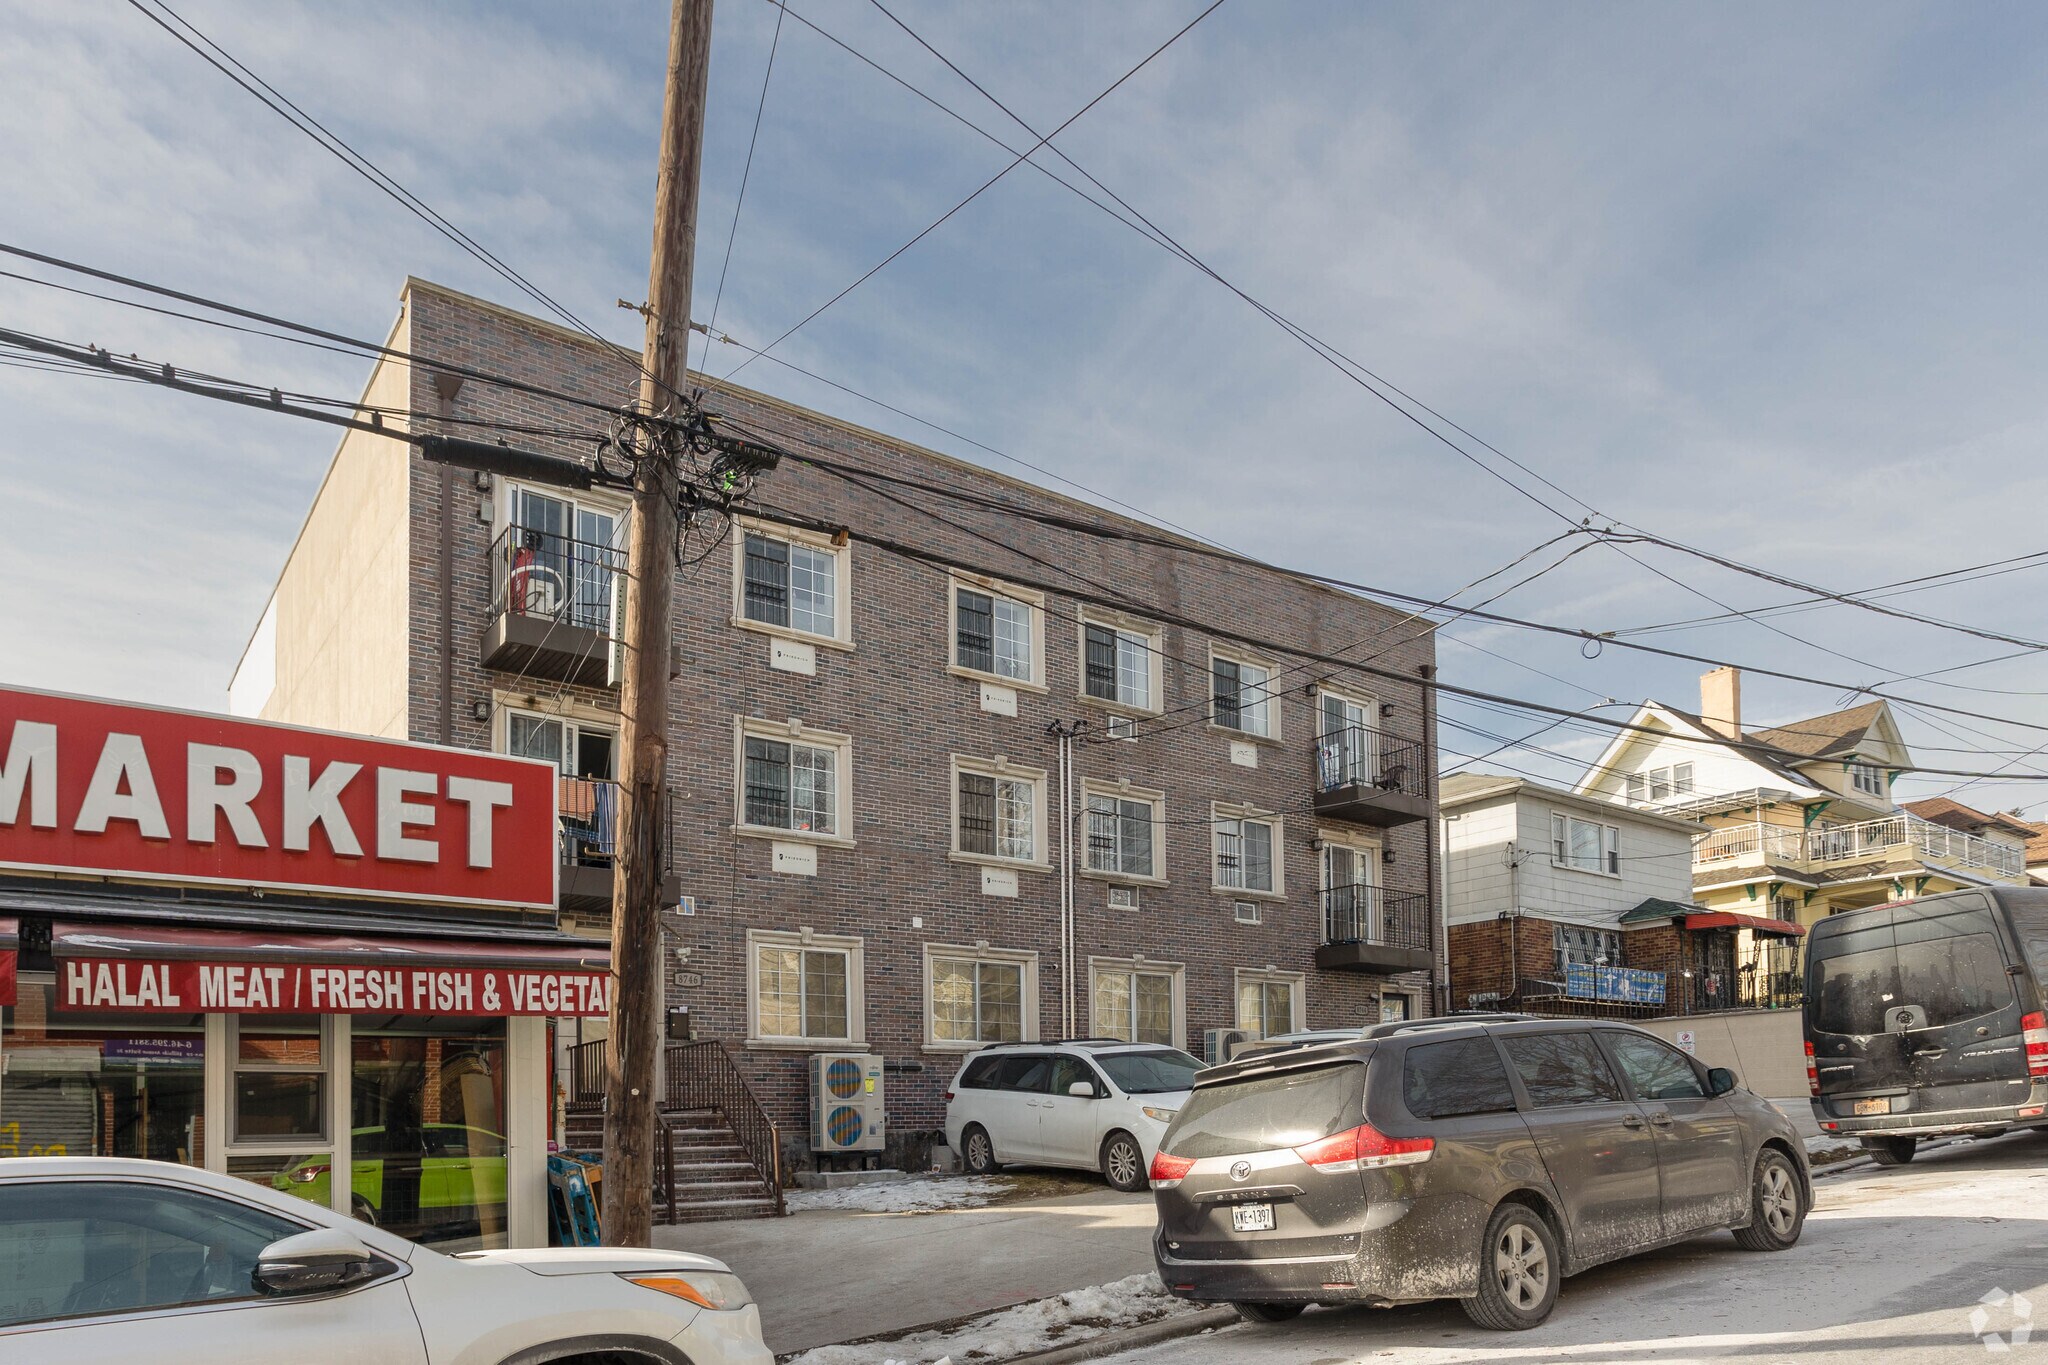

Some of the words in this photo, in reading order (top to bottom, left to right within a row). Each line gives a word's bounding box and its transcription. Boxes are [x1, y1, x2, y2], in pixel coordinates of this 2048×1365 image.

[67, 961, 180, 1007] HALAL
[200, 966, 284, 1009] MEAT
[294, 968, 301, 1008] /
[311, 968, 403, 1010] FRESH
[413, 971, 472, 1011] FISH
[483, 973, 501, 1011] &
[678, 975, 698, 984] 8746
